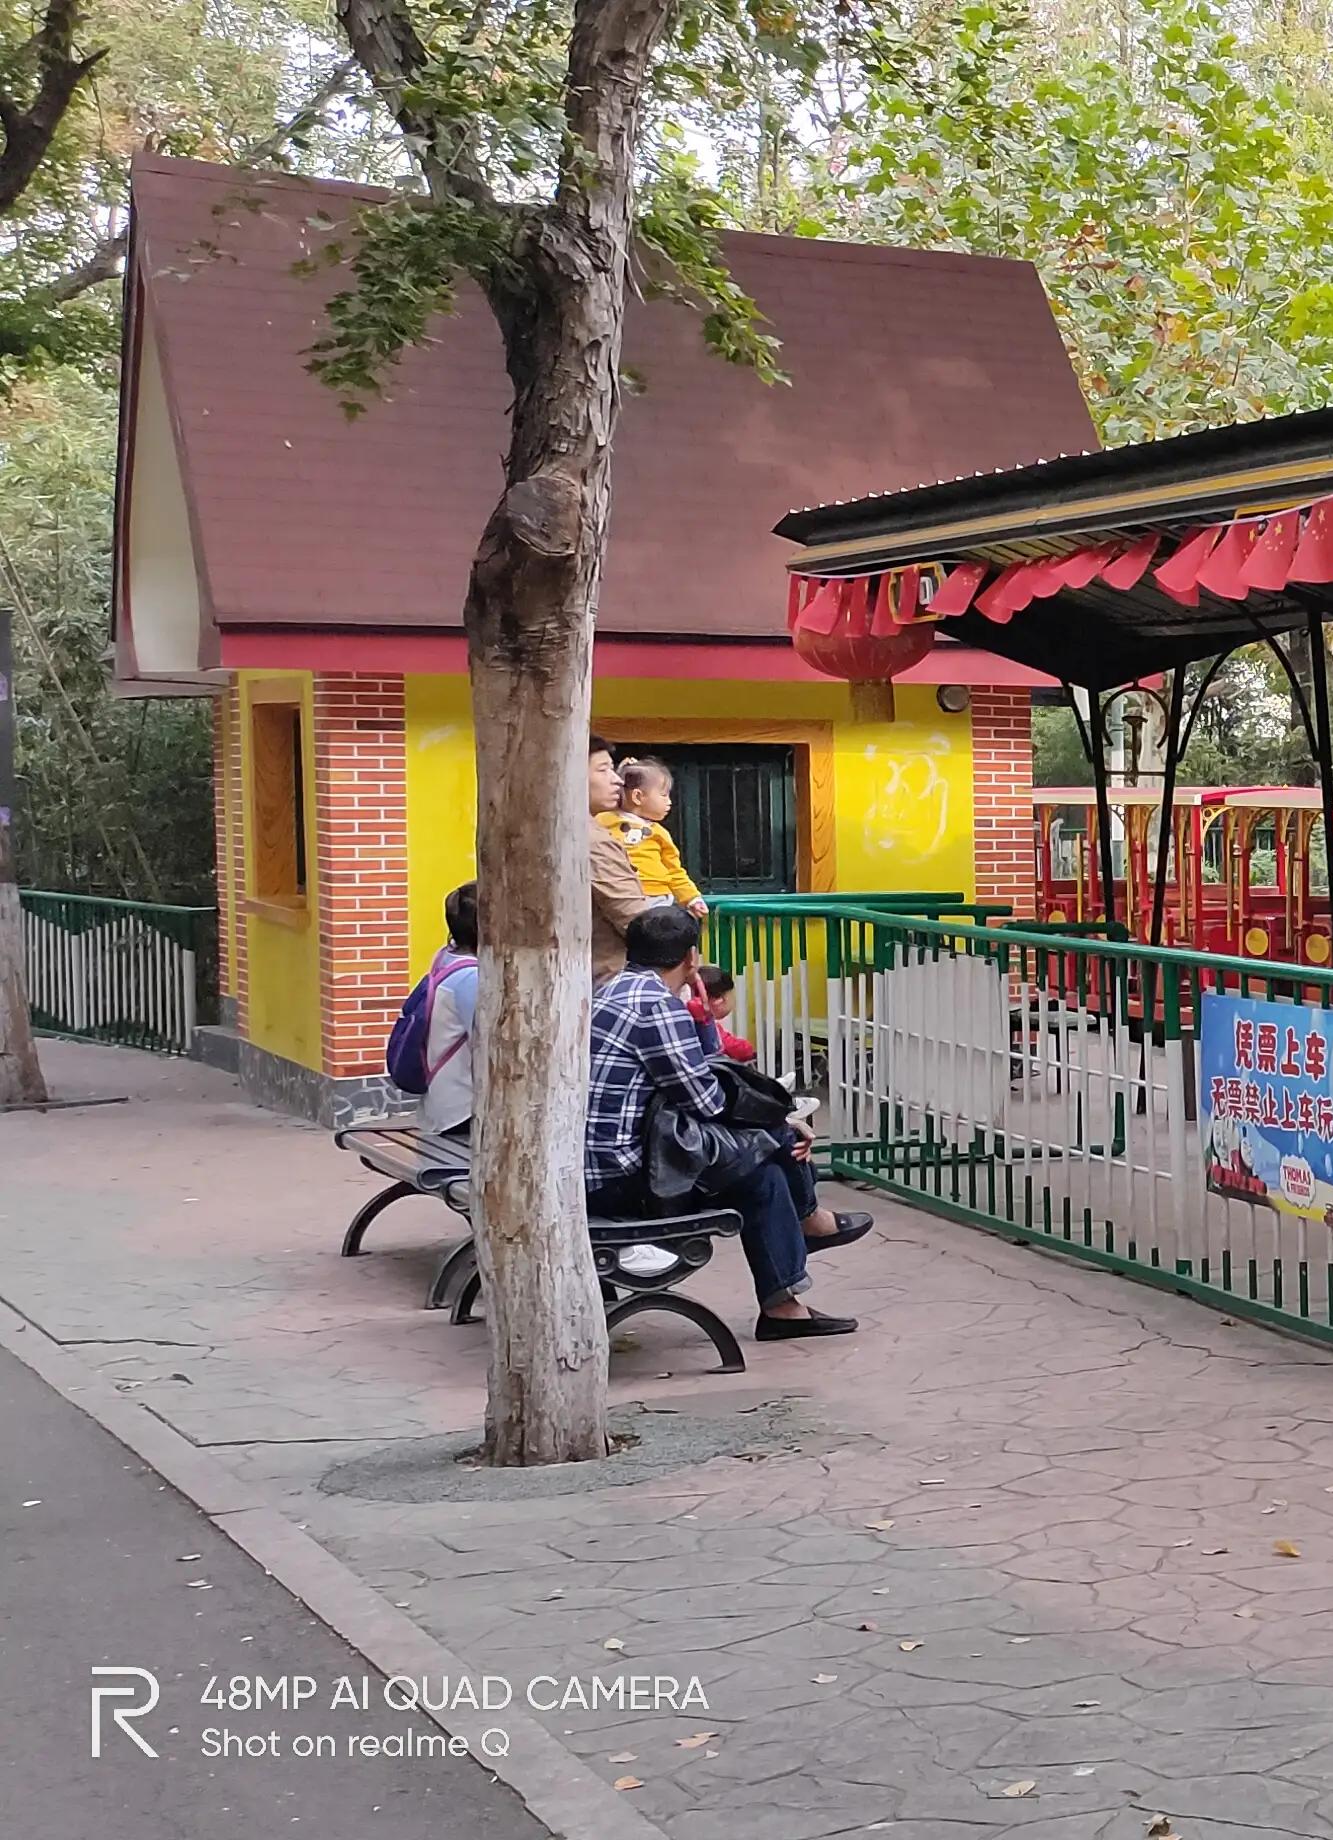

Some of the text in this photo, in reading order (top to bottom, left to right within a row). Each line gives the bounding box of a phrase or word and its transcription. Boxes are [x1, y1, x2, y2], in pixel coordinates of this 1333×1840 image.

[1235, 1019, 1327, 1082] 凭票上车
[1282, 1165, 1312, 1186] THOMAS
